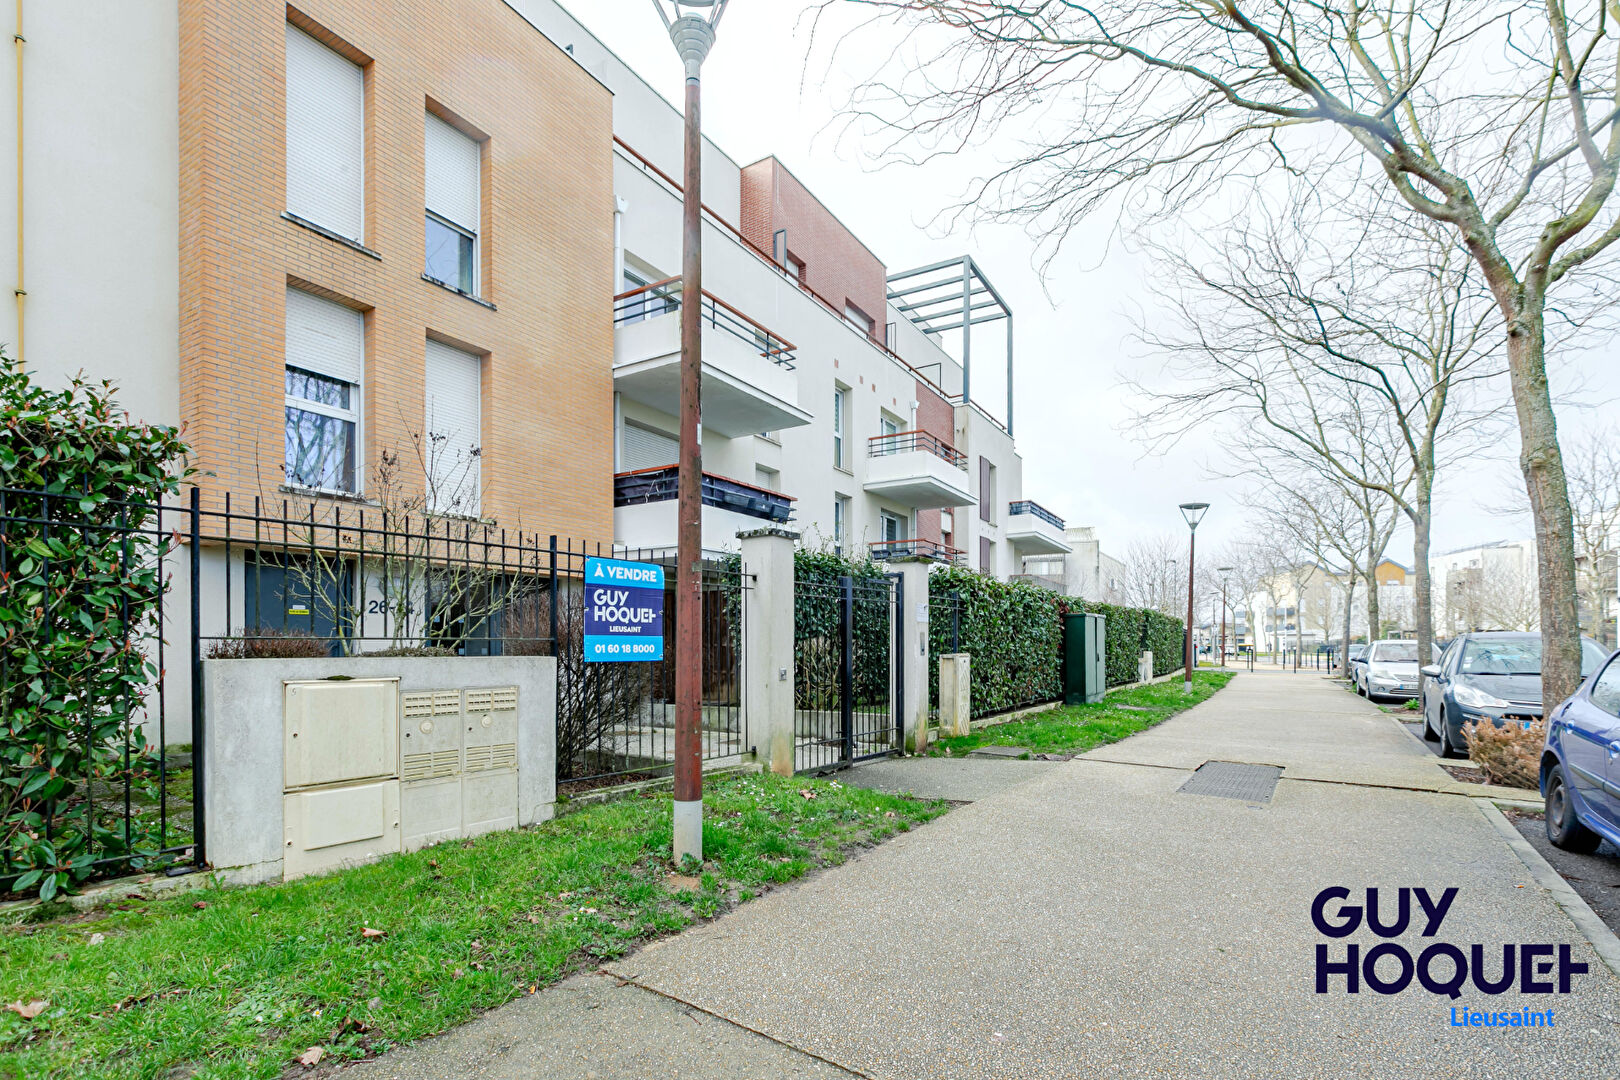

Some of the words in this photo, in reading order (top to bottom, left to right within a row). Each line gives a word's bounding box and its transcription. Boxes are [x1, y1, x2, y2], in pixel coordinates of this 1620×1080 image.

[594, 564, 604, 578] À
[606, 566, 657, 582] VENDRE
[593, 589, 629, 606] GUY
[594, 606, 656, 624] HOQUET
[595, 644, 606, 654] 01
[607, 644, 619, 654] 60
[622, 644, 630, 654] 18
[632, 644, 654, 654] 8000
